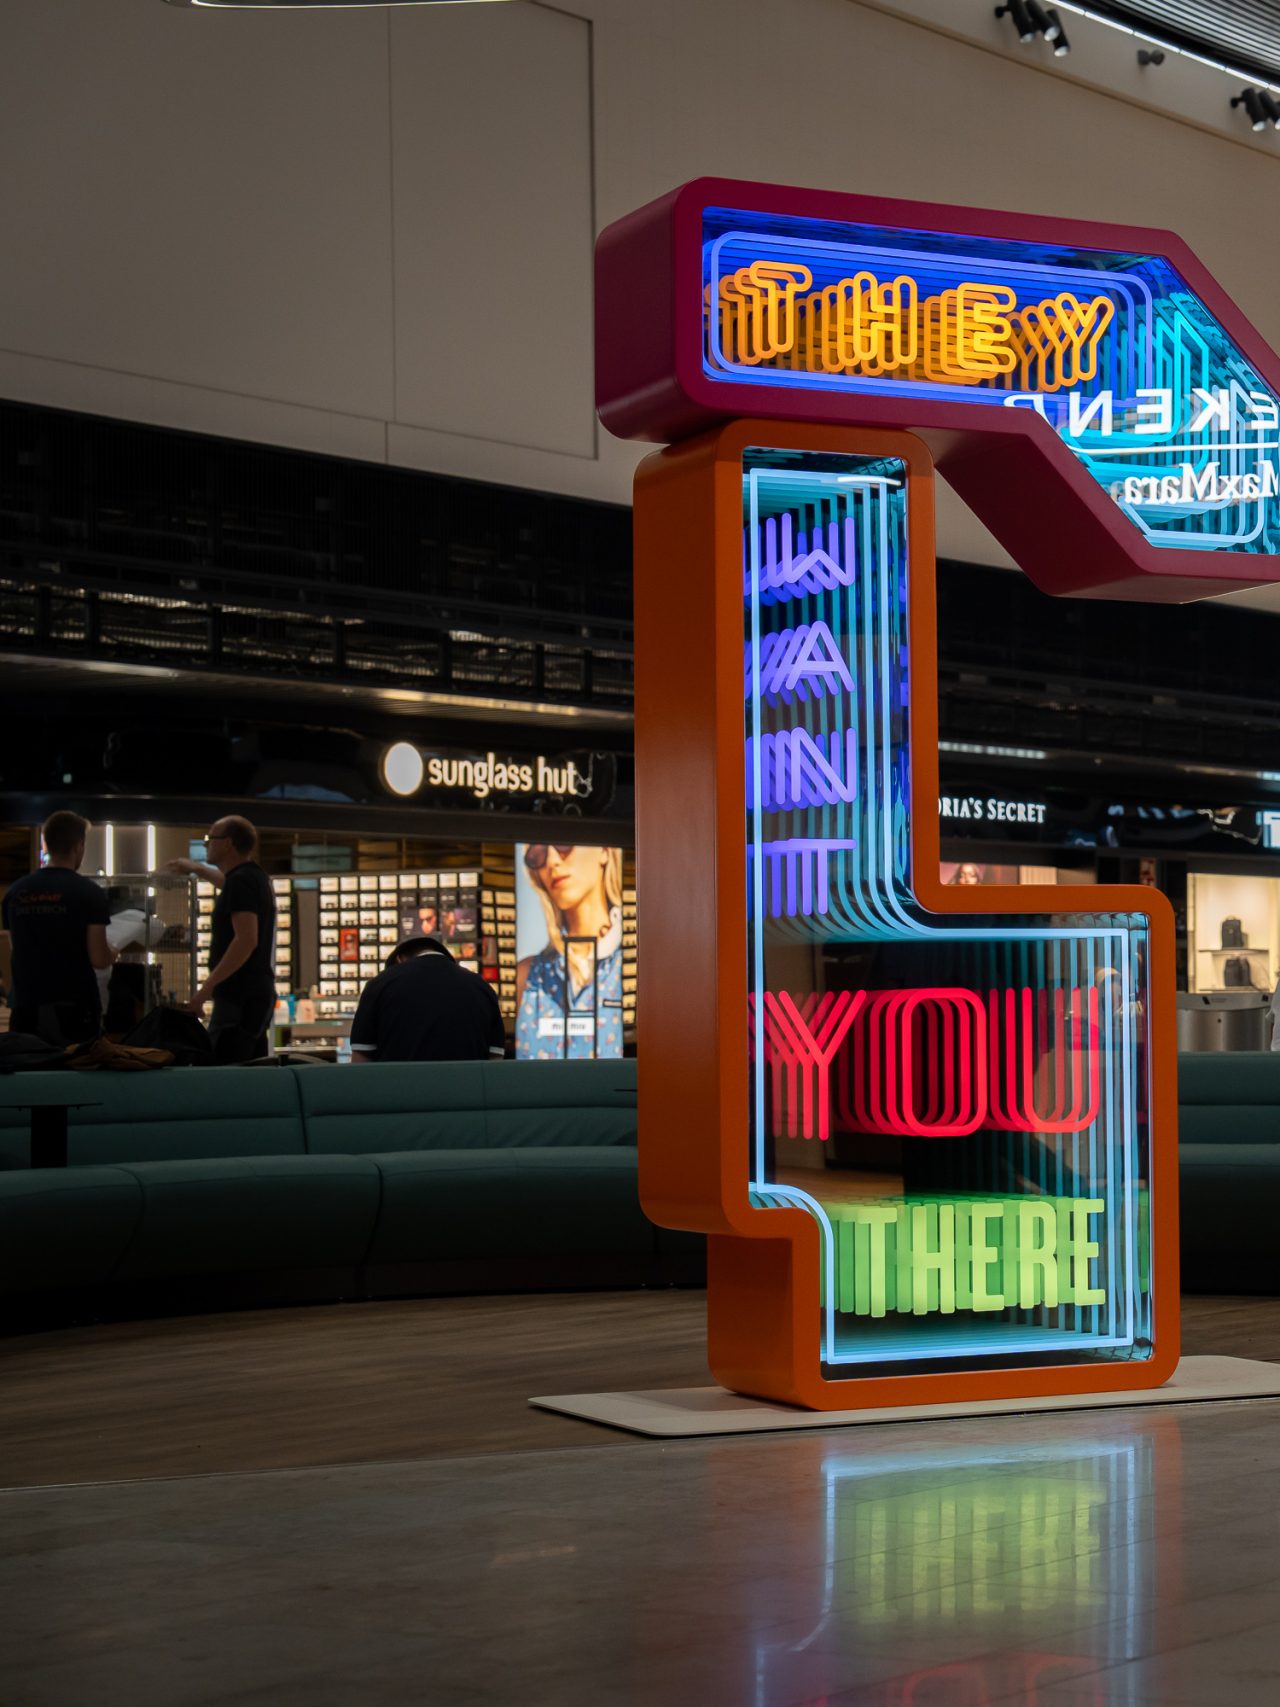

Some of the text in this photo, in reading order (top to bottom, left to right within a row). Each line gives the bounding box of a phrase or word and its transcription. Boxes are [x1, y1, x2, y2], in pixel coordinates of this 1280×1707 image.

[748, 259, 1115, 382] THEY
[781, 512, 857, 916] WANT
[428, 752, 579, 799] sunglass hut
[986, 798, 1047, 823] SECRET
[778, 985, 1100, 1141] YOU
[856, 1198, 1106, 1318] THERE
